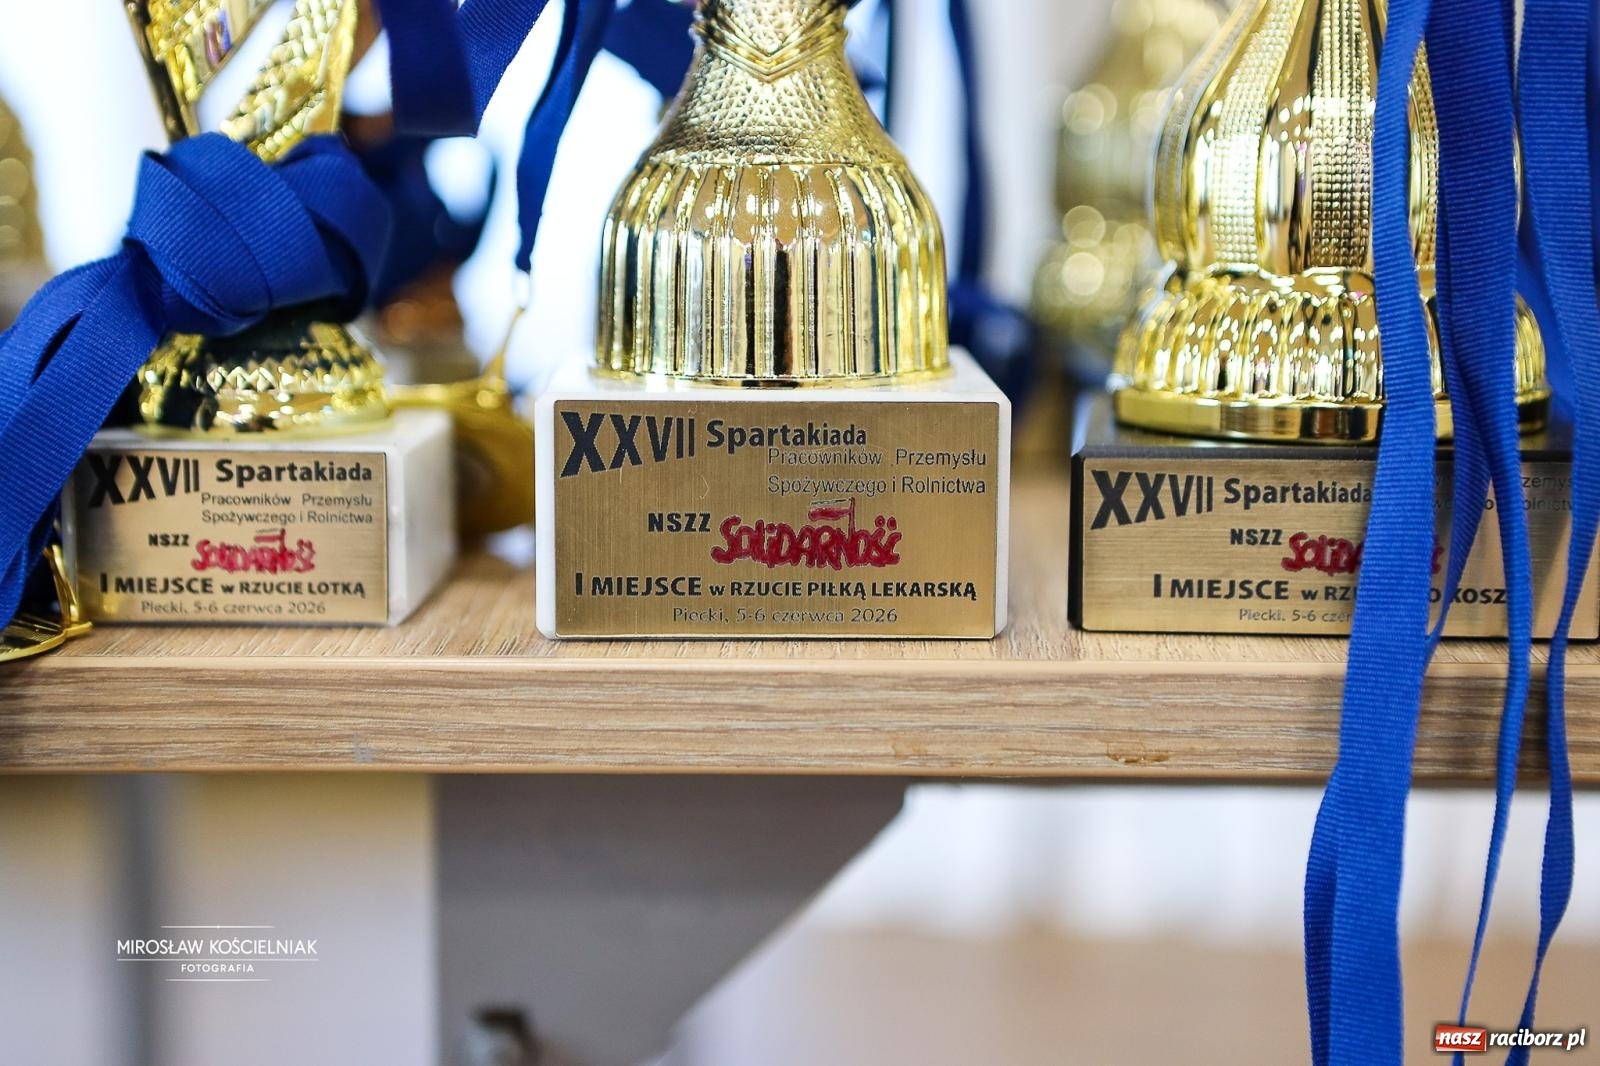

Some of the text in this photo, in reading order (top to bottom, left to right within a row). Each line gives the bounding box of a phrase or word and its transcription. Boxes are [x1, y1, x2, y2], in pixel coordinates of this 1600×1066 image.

[559, 411, 867, 478] XXVII Spartakiada
[768, 448, 987, 470] Pracowników Przemysłu
[87, 454, 373, 508] XXVII Spartakiada
[767, 475, 986, 498] Spożywczego i Rolnictwa
[201, 492, 372, 509] Pracowników Przemysłu
[1090, 469, 1373, 530] XXVII Spartakiada
[201, 509, 296, 526] Spożywczego
[307, 511, 373, 524] Rolnictwa
[647, 512, 712, 533] NSZZ
[148, 533, 190, 547] NSZZ
[1230, 528, 1283, 545] NSZZ
[100, 573, 108, 594] I
[114, 577, 214, 595] MIEJSCE
[239, 581, 304, 595] RZUCIE
[307, 581, 366, 599] LOTKĄ
[575, 572, 977, 602] I MIEJSCE w RZUCIE PIŁKĄ LEKARSKĄ
[1153, 574, 1162, 598] I
[1170, 579, 1289, 600] MIEJSCE
[193, 601, 219, 614] 5-6
[222, 604, 282, 614] czerwca
[288, 602, 326, 615] 2026
[672, 607, 899, 625] Piecki, 5-6 czerwca 2026
[1292, 610, 1316, 622] 5-6
